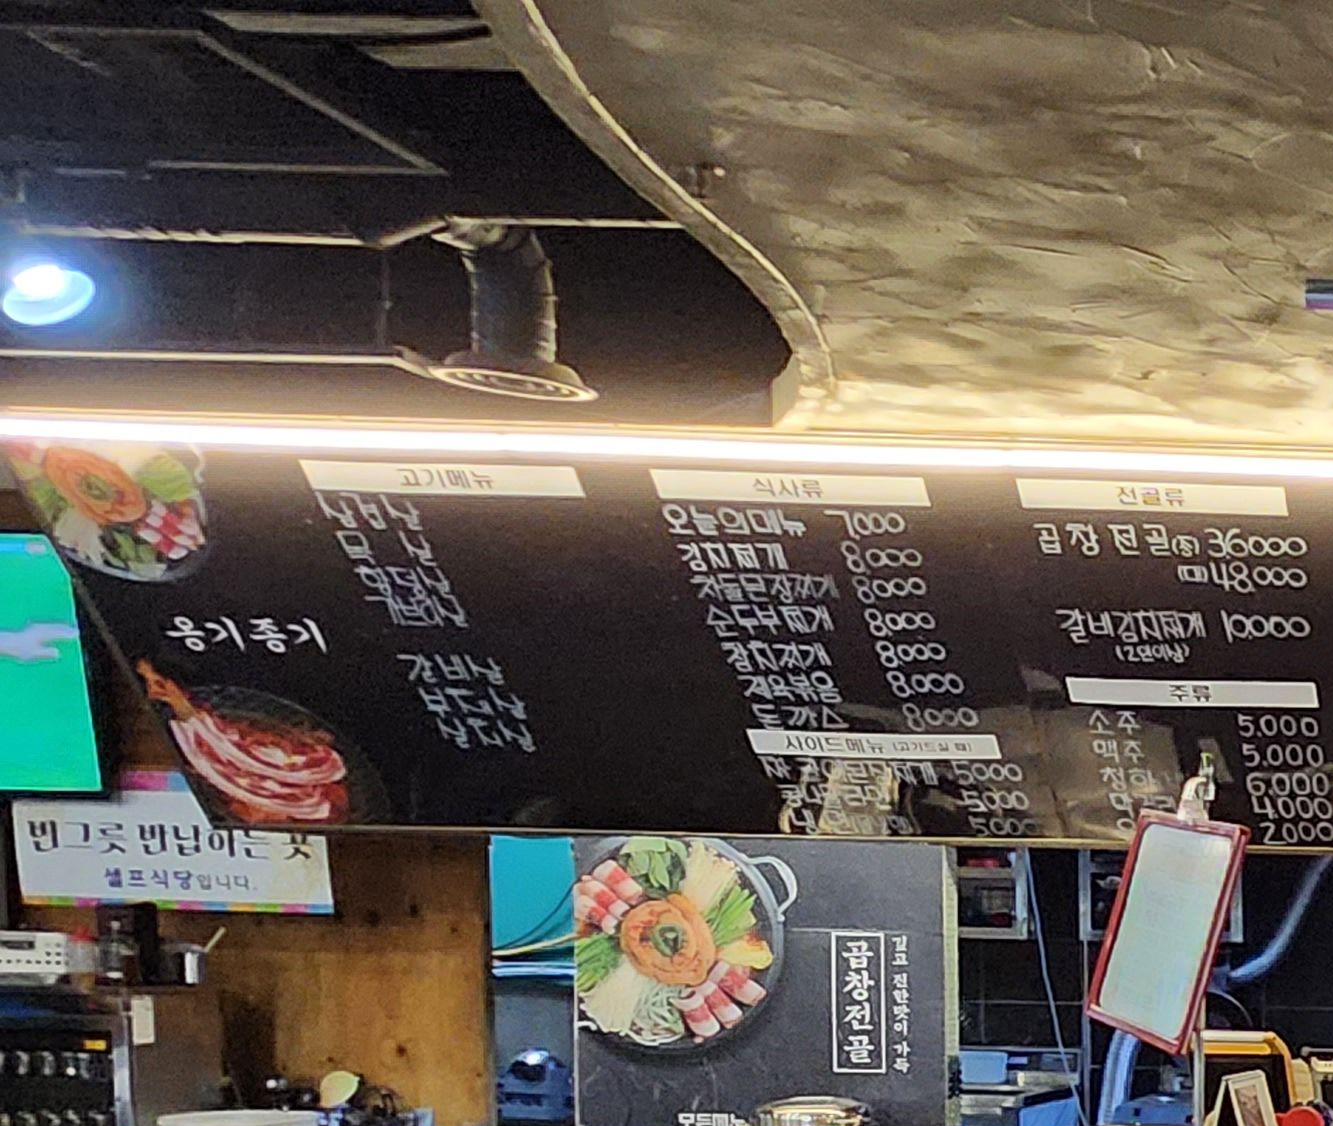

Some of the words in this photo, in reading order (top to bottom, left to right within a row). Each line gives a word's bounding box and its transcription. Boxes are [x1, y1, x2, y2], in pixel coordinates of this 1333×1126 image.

[396, 468, 493, 489] 고기메뉴
[752, 478, 824, 499] 식사류
[1116, 486, 1185, 506] 전골류
[165, 616, 328, 653] 옹기종기
[1169, 684, 1213, 703] 주류
[1089, 709, 1141, 735] 소주
[785, 734, 885, 754] 사이드메뉴
[1092, 739, 1145, 764] 맥주
[27, 819, 126, 854] 빈그릇
[103, 867, 258, 891] 셀프식당입니다.
[841, 939, 876, 1064] 곱창전골
